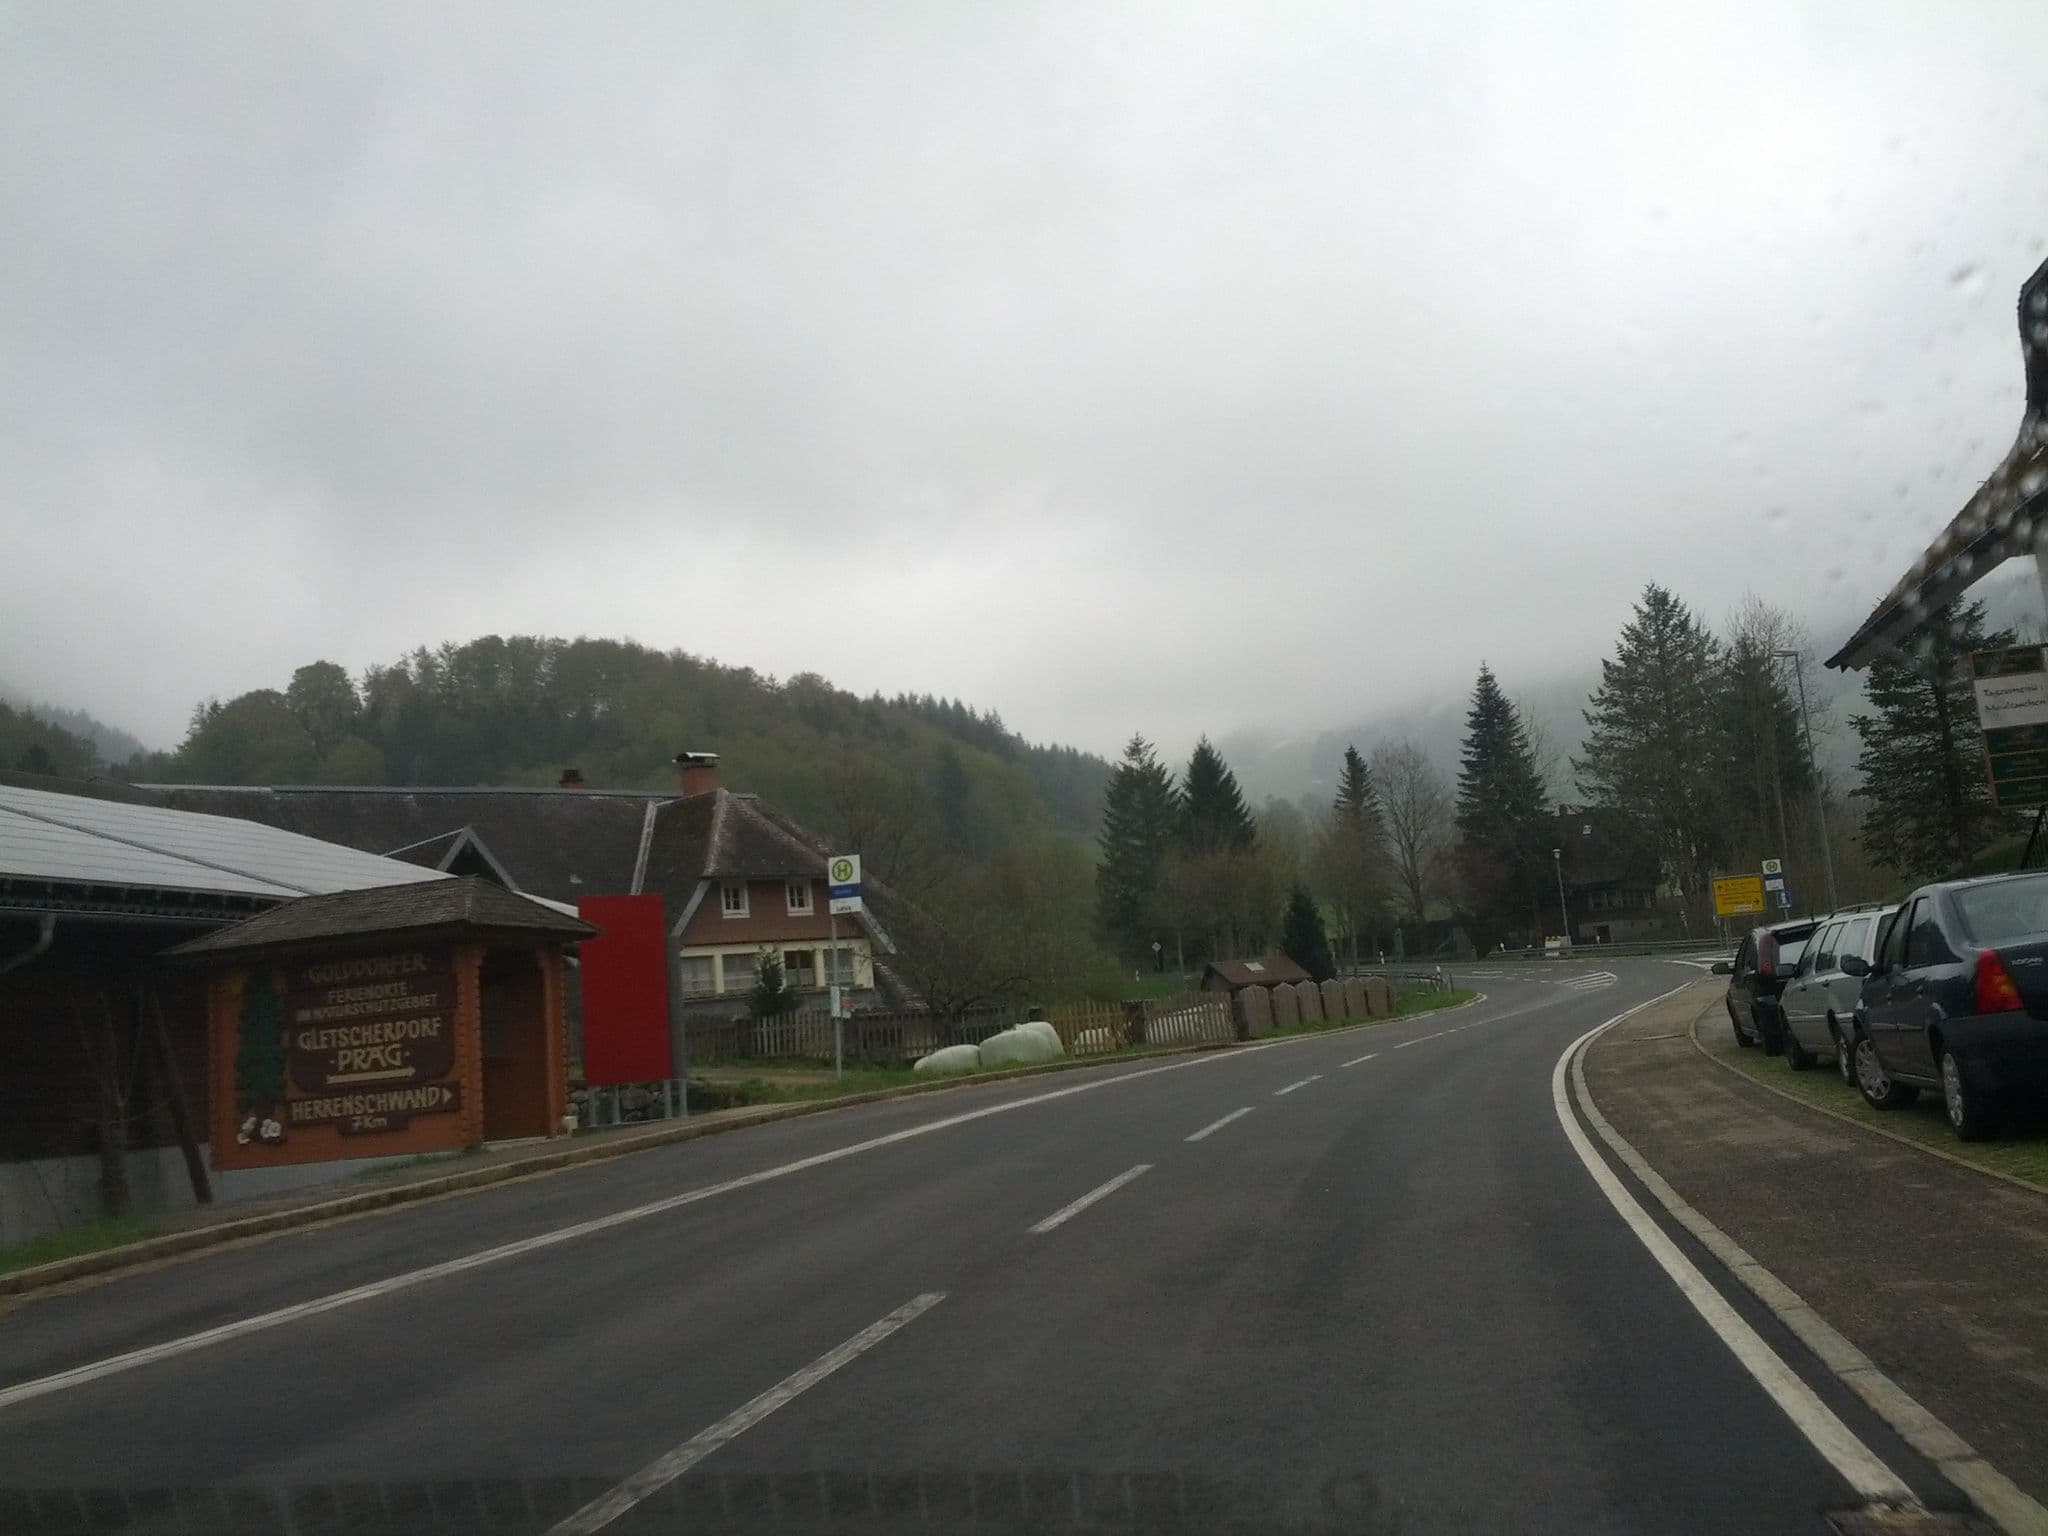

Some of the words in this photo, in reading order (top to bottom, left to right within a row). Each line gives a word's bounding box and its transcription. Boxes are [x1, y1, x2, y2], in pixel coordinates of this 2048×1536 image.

[327, 982, 408, 1004] FERIENORTE
[298, 1017, 441, 1050] GLETSCHERDORF
[292, 1087, 440, 1120] HERRENSCHWAND
